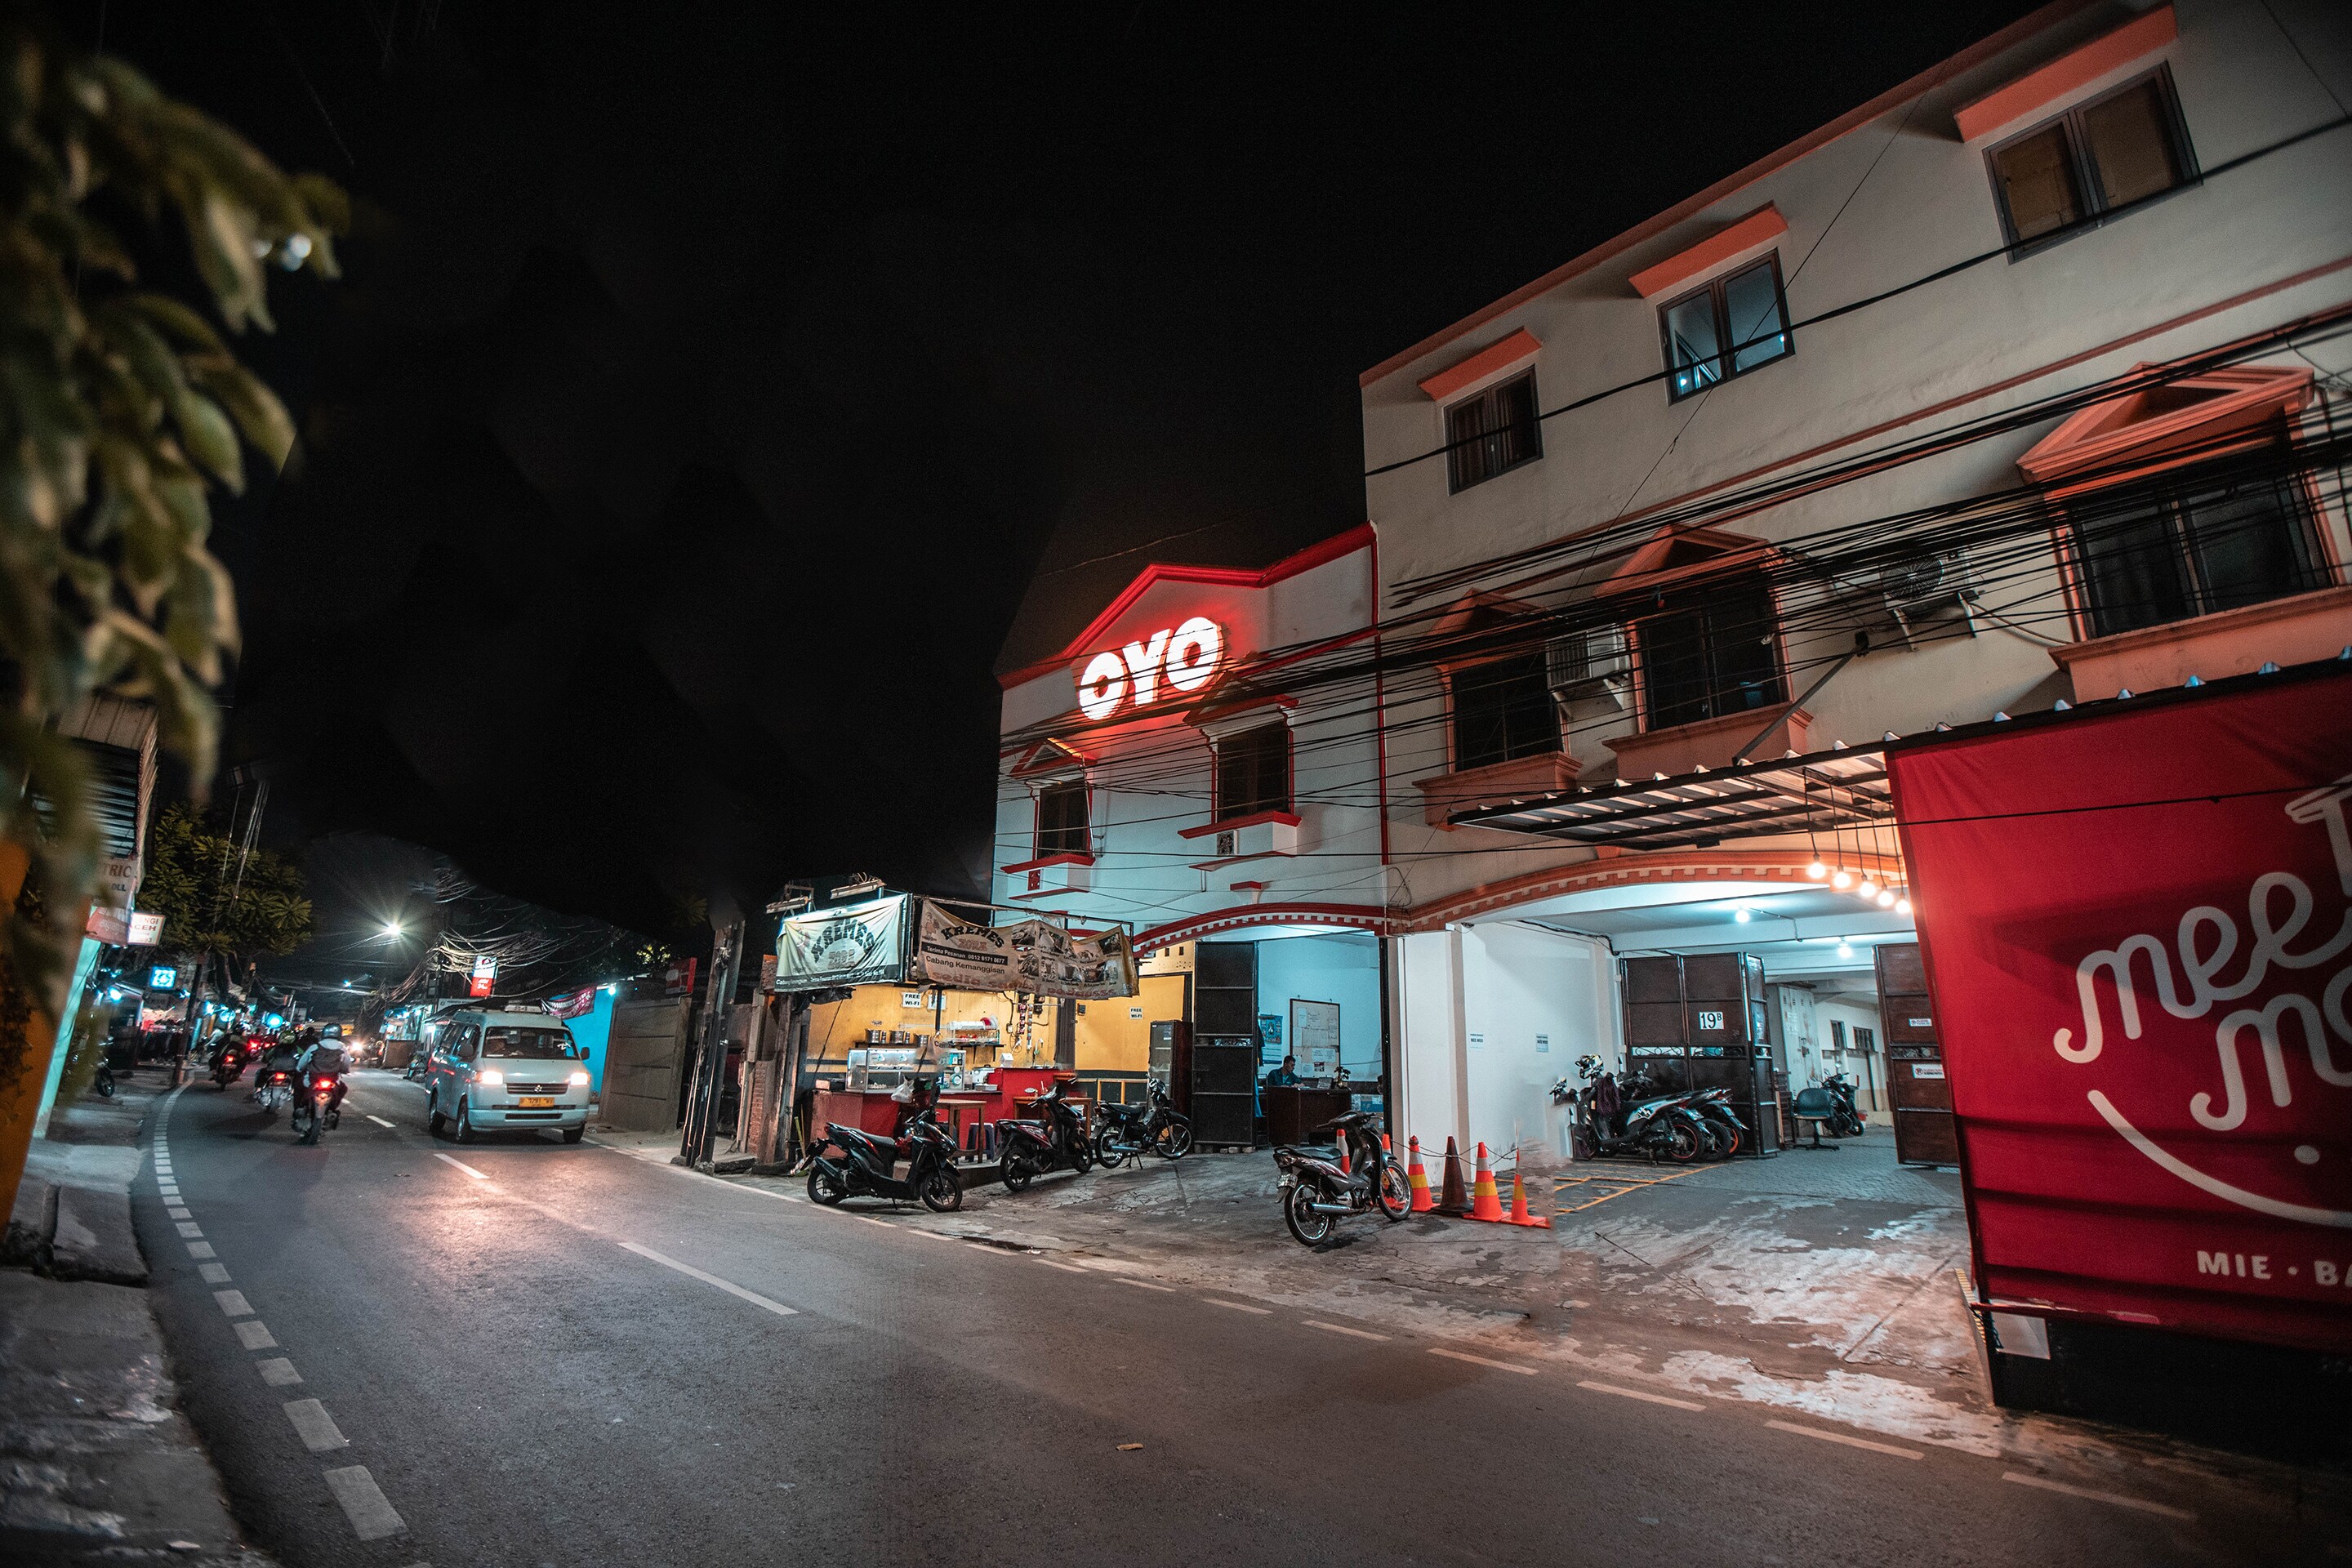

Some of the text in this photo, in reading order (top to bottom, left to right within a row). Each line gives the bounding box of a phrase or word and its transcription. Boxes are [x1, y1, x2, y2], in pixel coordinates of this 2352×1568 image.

[1079, 617, 1223, 720] OYO
[941, 925, 1004, 949] KREMES
[927, 946, 944, 955] Terima
[944, 948, 966, 958] Pesanan
[926, 956, 1005, 974] Cabang Kemanggisan
[2197, 1250, 2272, 1280] MIE
